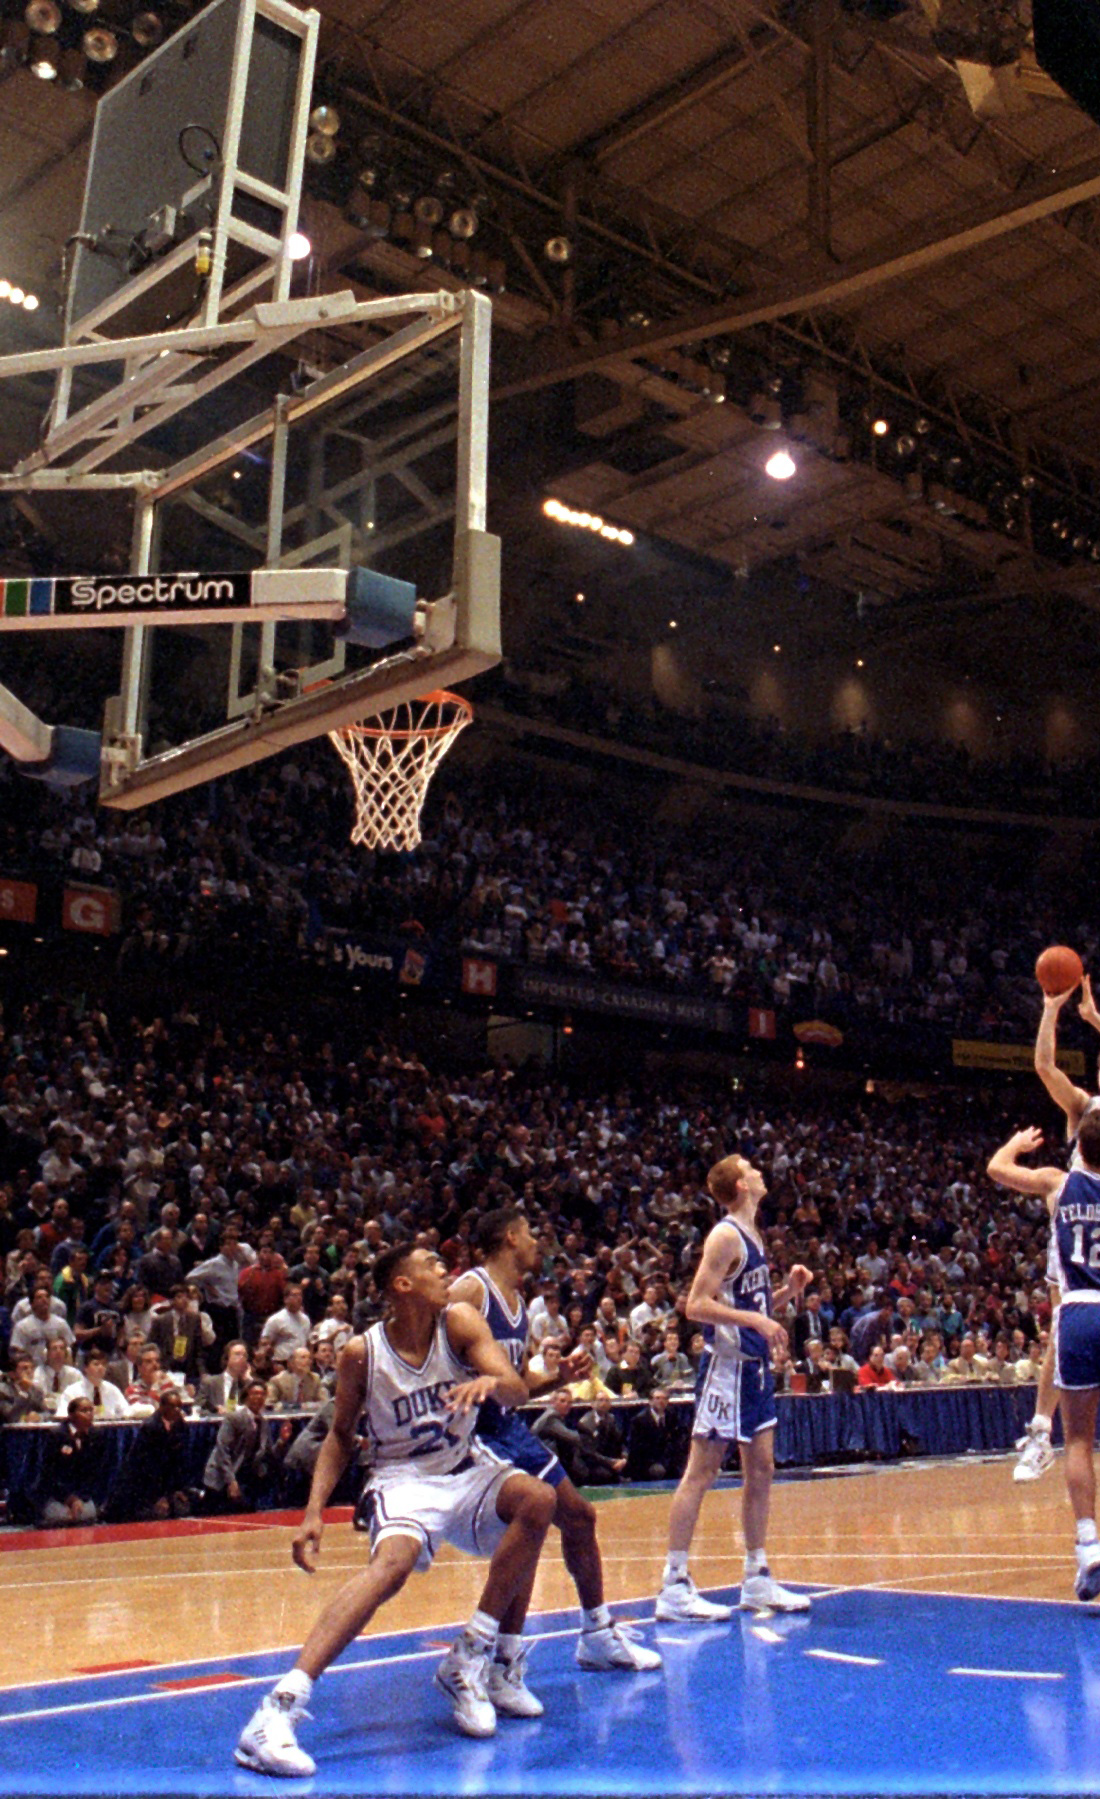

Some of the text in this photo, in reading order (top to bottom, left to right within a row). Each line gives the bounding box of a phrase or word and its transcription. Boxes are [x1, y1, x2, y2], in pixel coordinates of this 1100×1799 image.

[71, 577, 234, 610] Spectrum
[69, 896, 105, 929] G
[469, 963, 492, 992] H
[708, 1394, 731, 1421] UK
